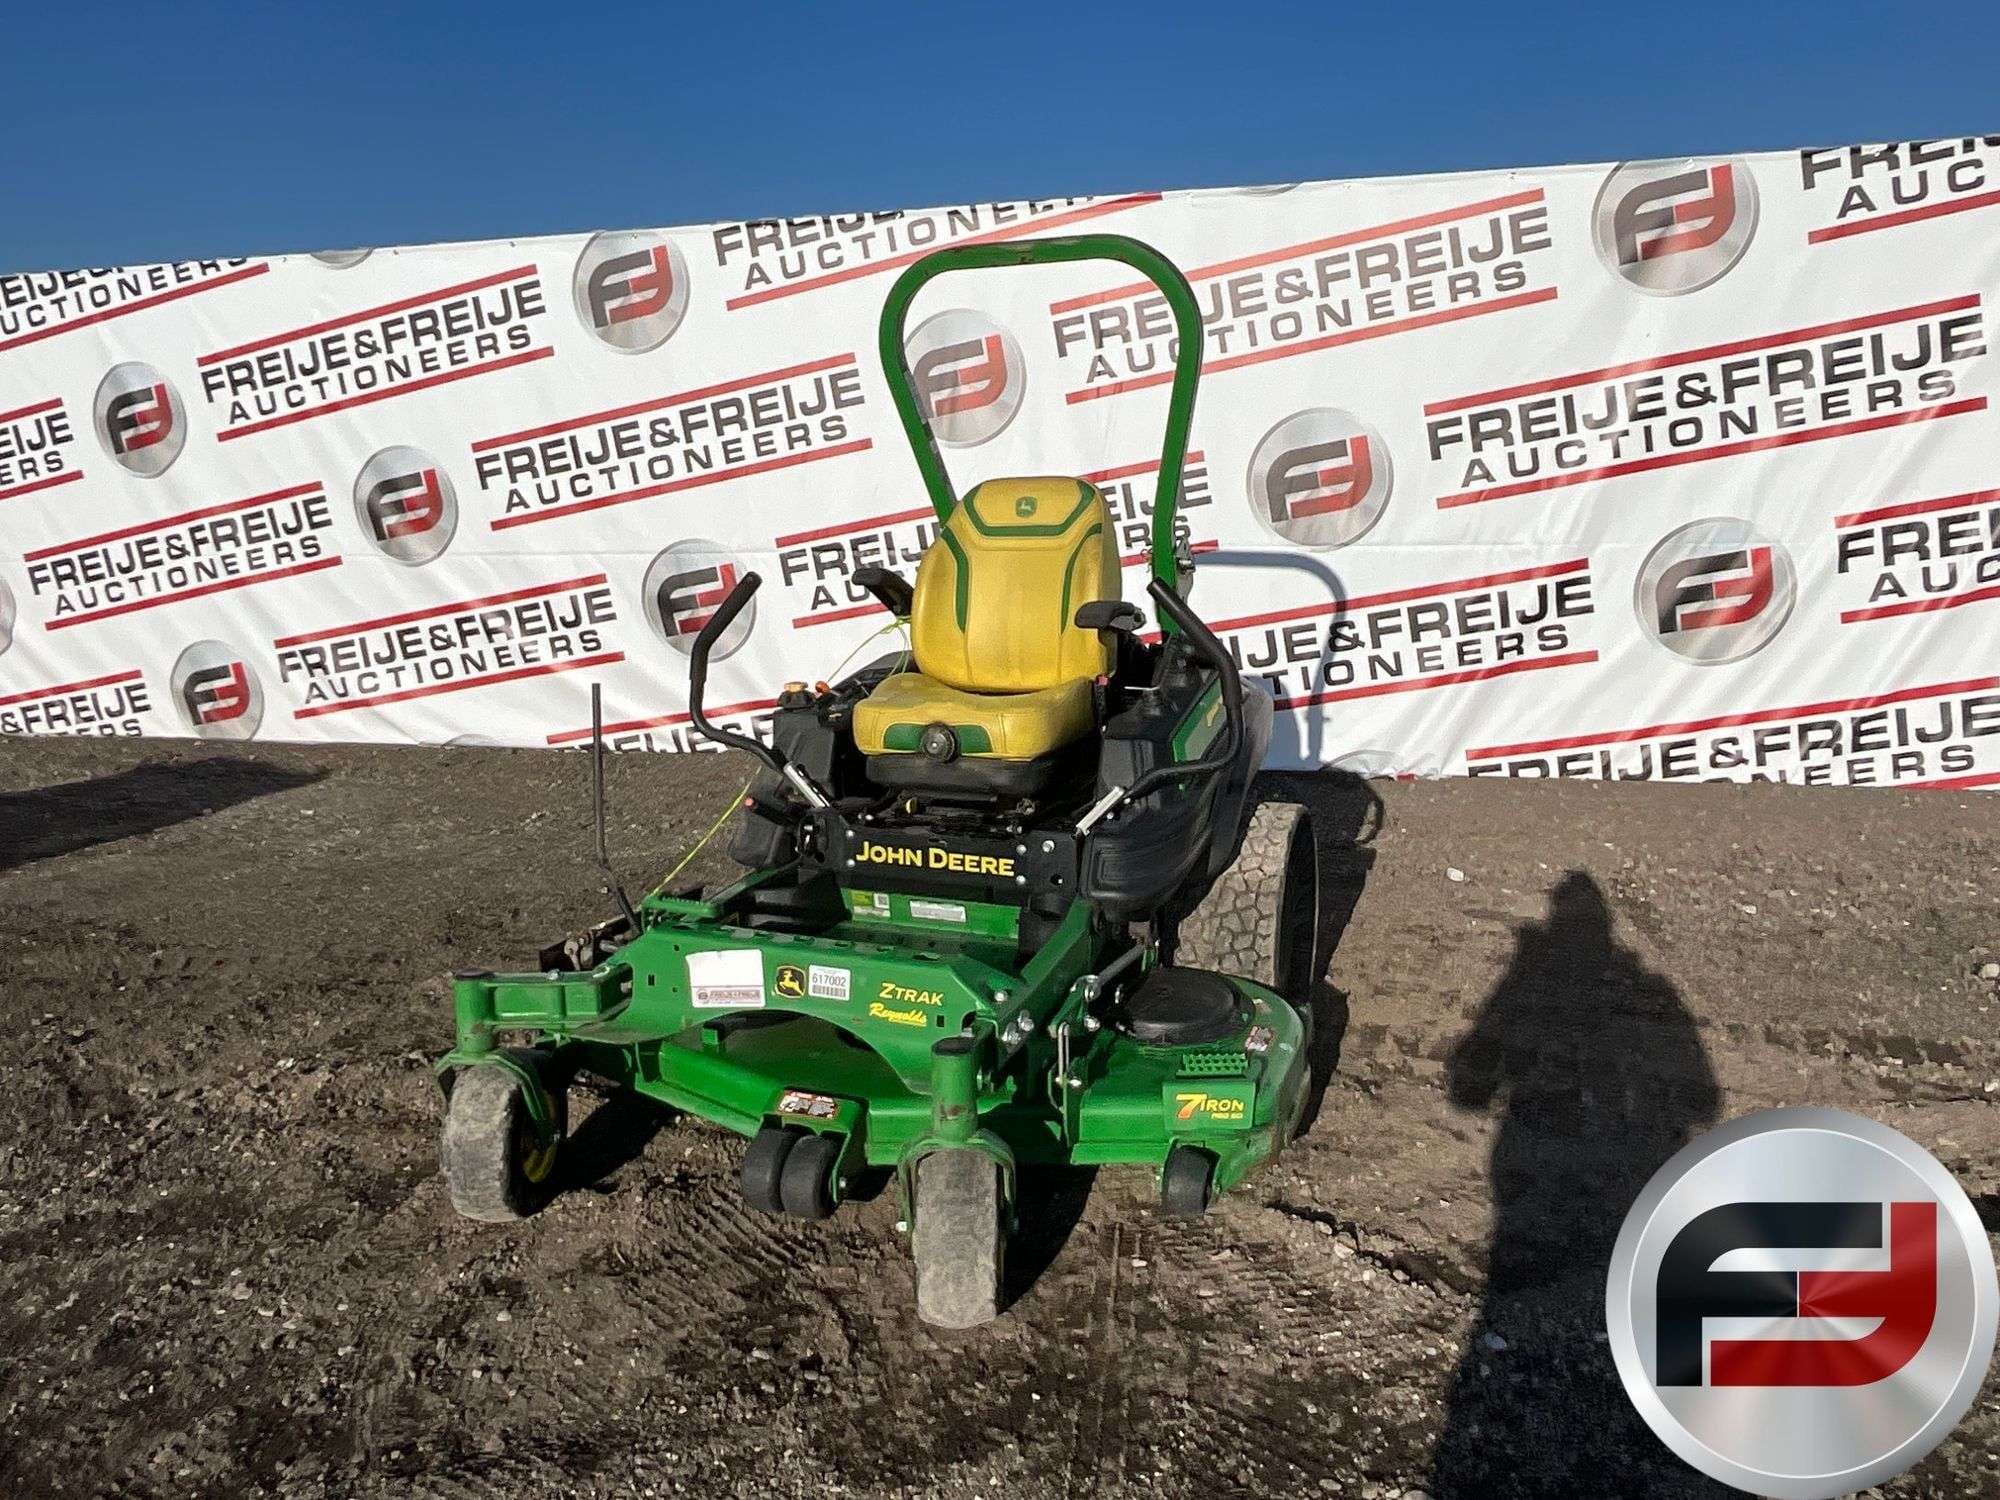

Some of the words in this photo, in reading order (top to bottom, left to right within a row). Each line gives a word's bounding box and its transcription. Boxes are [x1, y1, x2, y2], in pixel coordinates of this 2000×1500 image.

[1837, 158, 1985, 219] AUC
[1052, 207, 1553, 358] FREJE&FREIJE
[201, 279, 546, 403] FREIJE&FREIJE
[229, 324, 531, 424] AUCTIONEERS
[1426, 313, 1988, 461] FREIJE&FREIJE
[475, 368, 865, 490] FREIJE&FREIJE
[505, 415, 847, 513] AUCTIONEERS
[1461, 369, 1956, 488] AUCTIONEERS
[27, 495, 333, 596] FREIJE&FREIJE
[55, 535, 322, 616] AUCTIONEERS
[277, 588, 617, 683] FREIJE&FREIJE
[304, 629, 602, 704] AUCTIONEERS
[856, 841, 922, 867] JOHN
[929, 847, 1015, 877] DEERE
[812, 973, 846, 987] 617002
[879, 982, 944, 1006] ZTRAK
